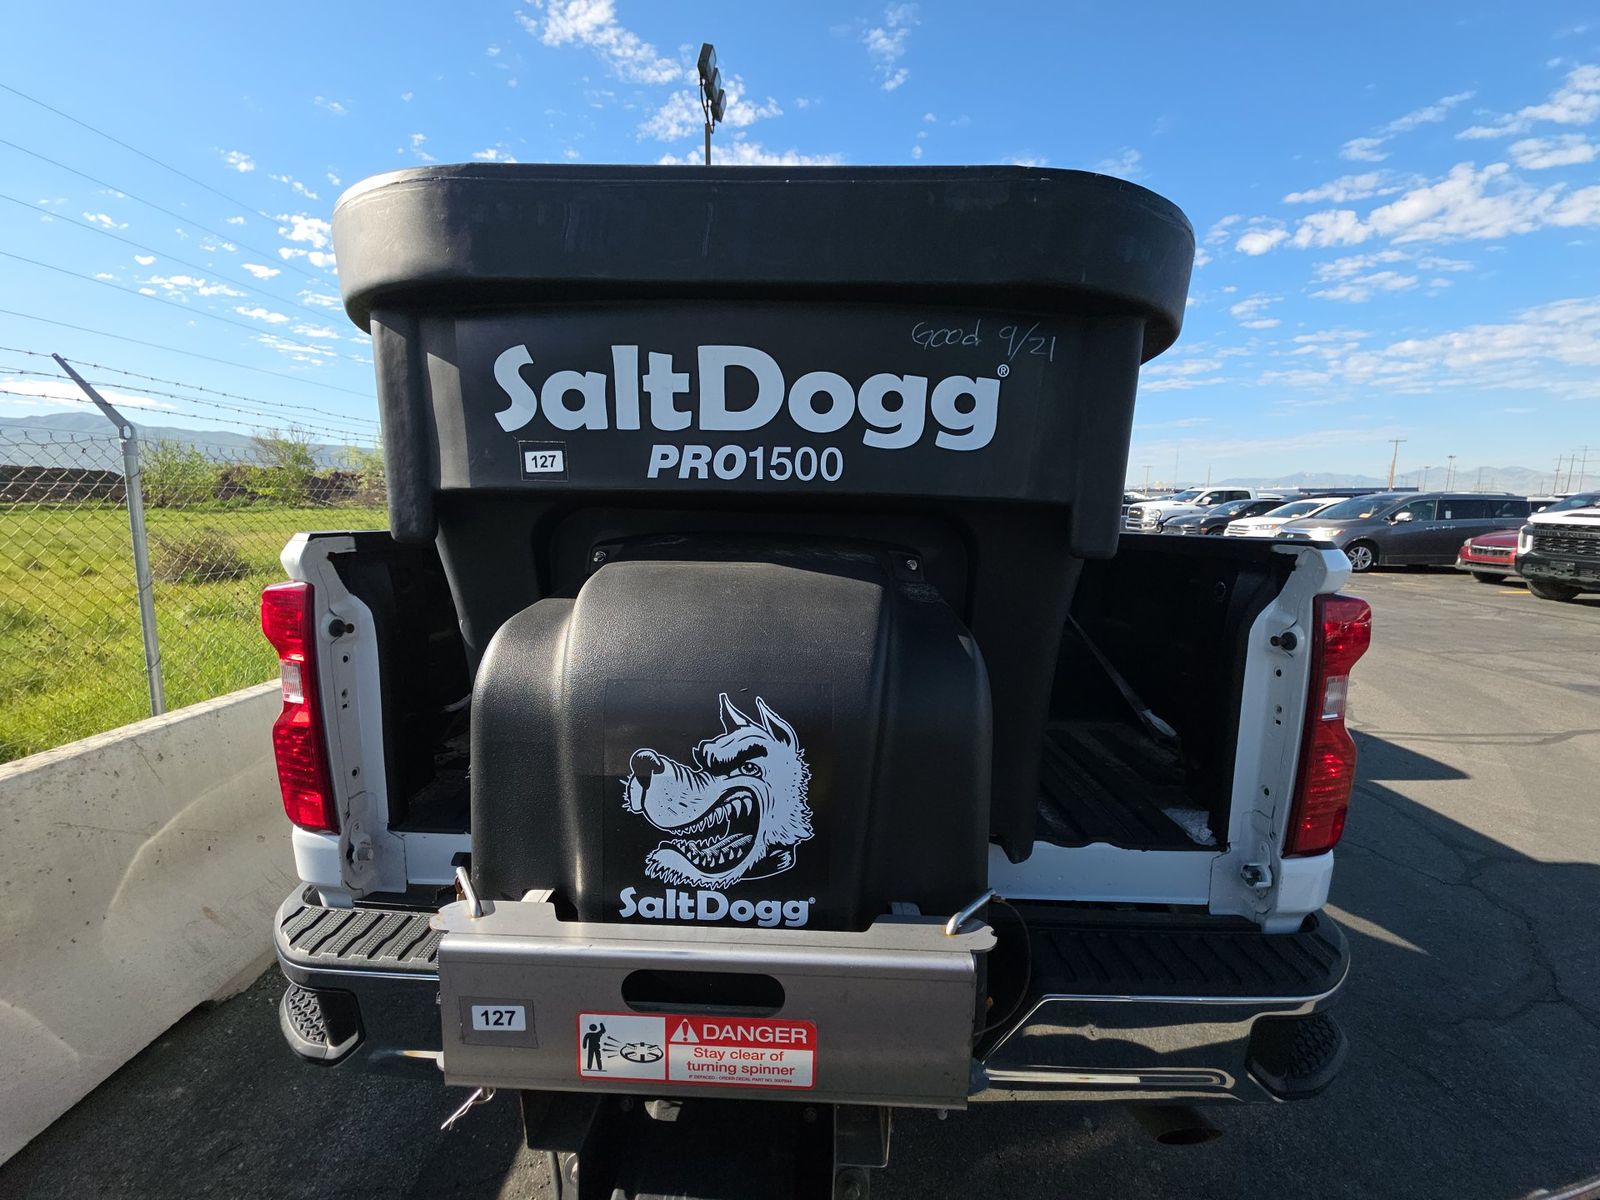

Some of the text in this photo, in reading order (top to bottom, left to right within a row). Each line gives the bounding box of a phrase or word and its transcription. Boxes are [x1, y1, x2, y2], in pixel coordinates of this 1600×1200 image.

[911, 319, 1056, 362] Good 9/21
[531, 454, 557, 469] 127
[481, 1009, 516, 1026] 127
[702, 1023, 808, 1044] DANGER
[693, 1046, 785, 1062] Stay clear of
[686, 1060, 796, 1077] turning spinner
